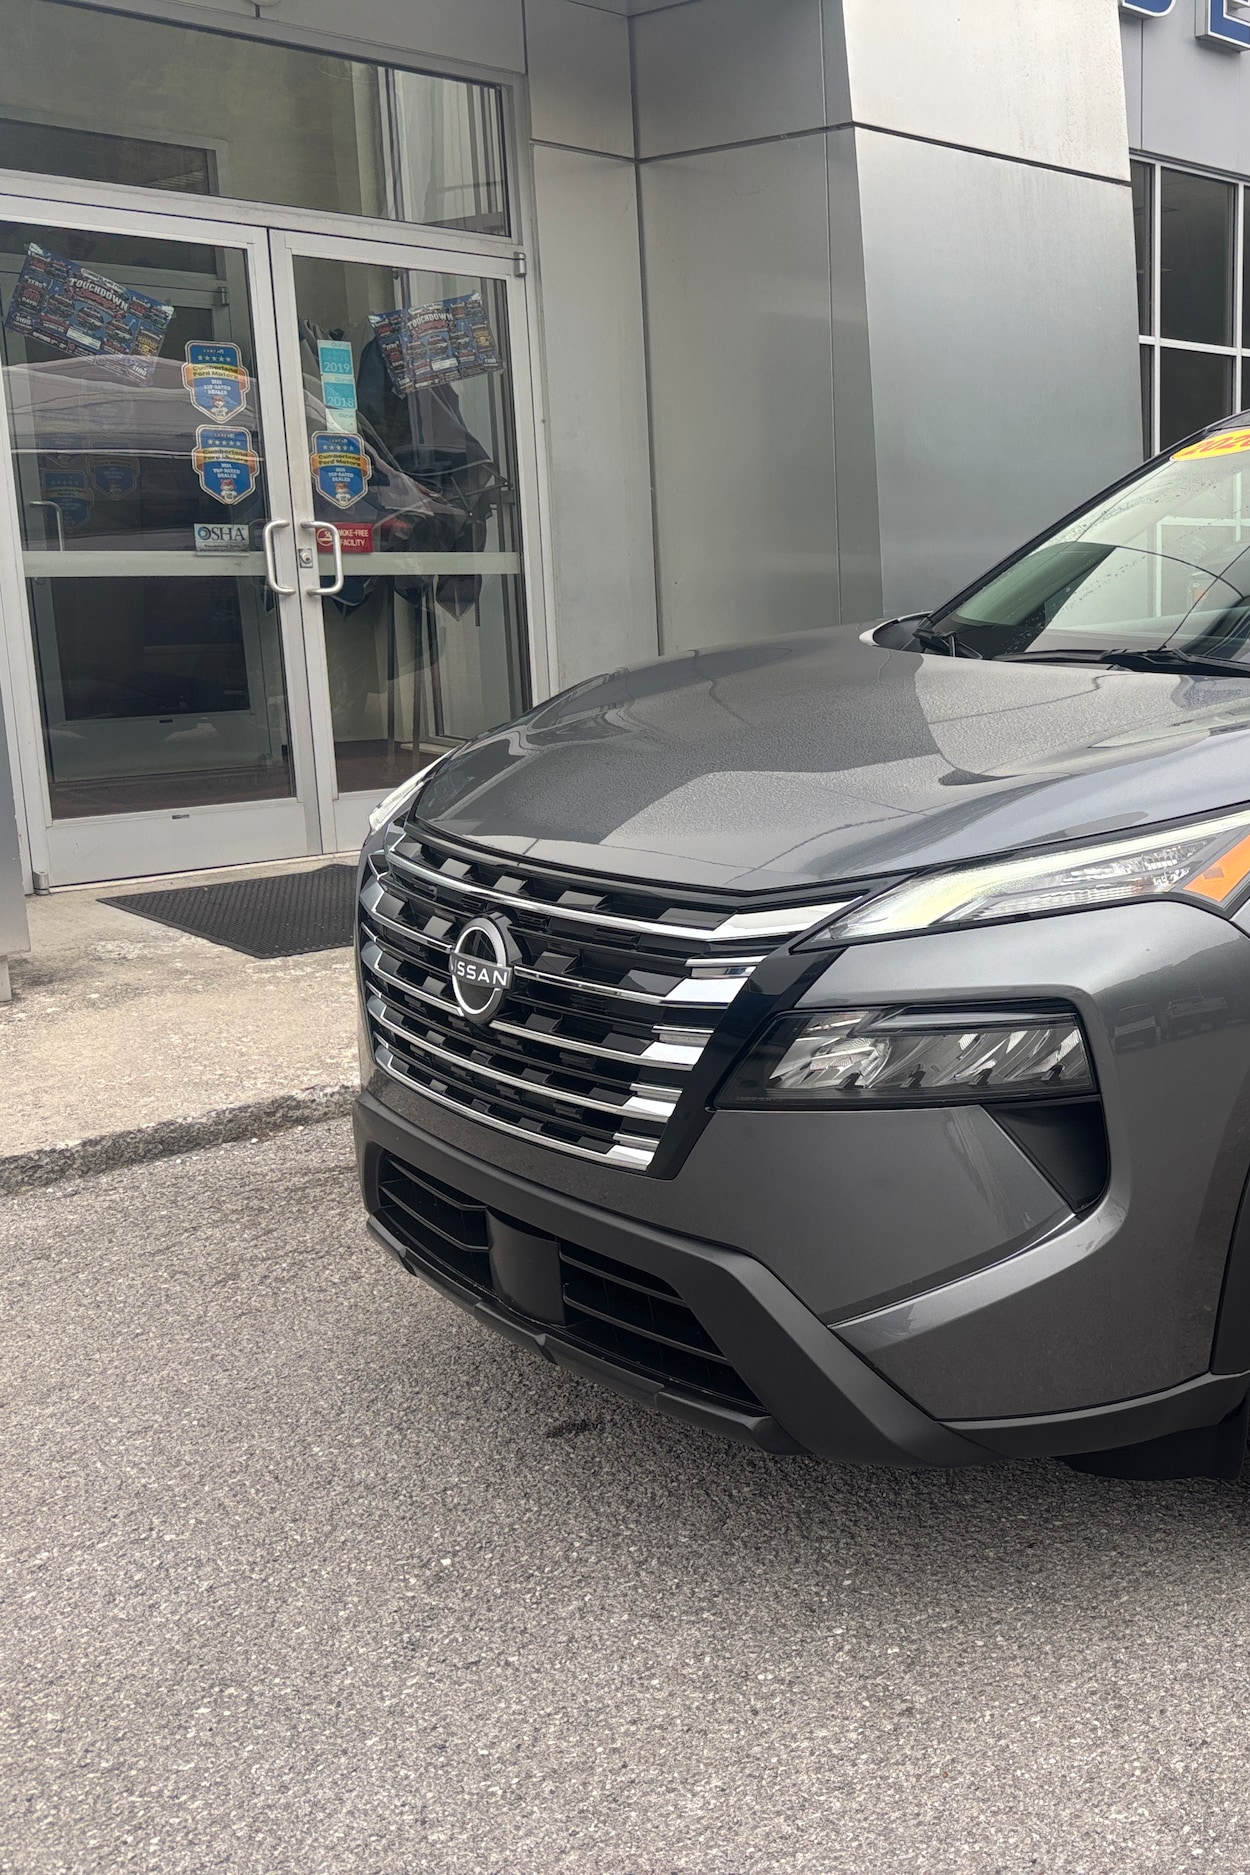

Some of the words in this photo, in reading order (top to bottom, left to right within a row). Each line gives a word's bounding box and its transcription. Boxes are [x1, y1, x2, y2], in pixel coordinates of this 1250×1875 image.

[69, 277, 129, 311] TOUCHDOWN
[407, 312, 454, 329] TOUCHDOWN
[324, 362, 350, 373] 2019
[327, 396, 354, 408] 2018
[197, 526, 246, 540] OSHA
[339, 529, 369, 537] MOKE-FREE
